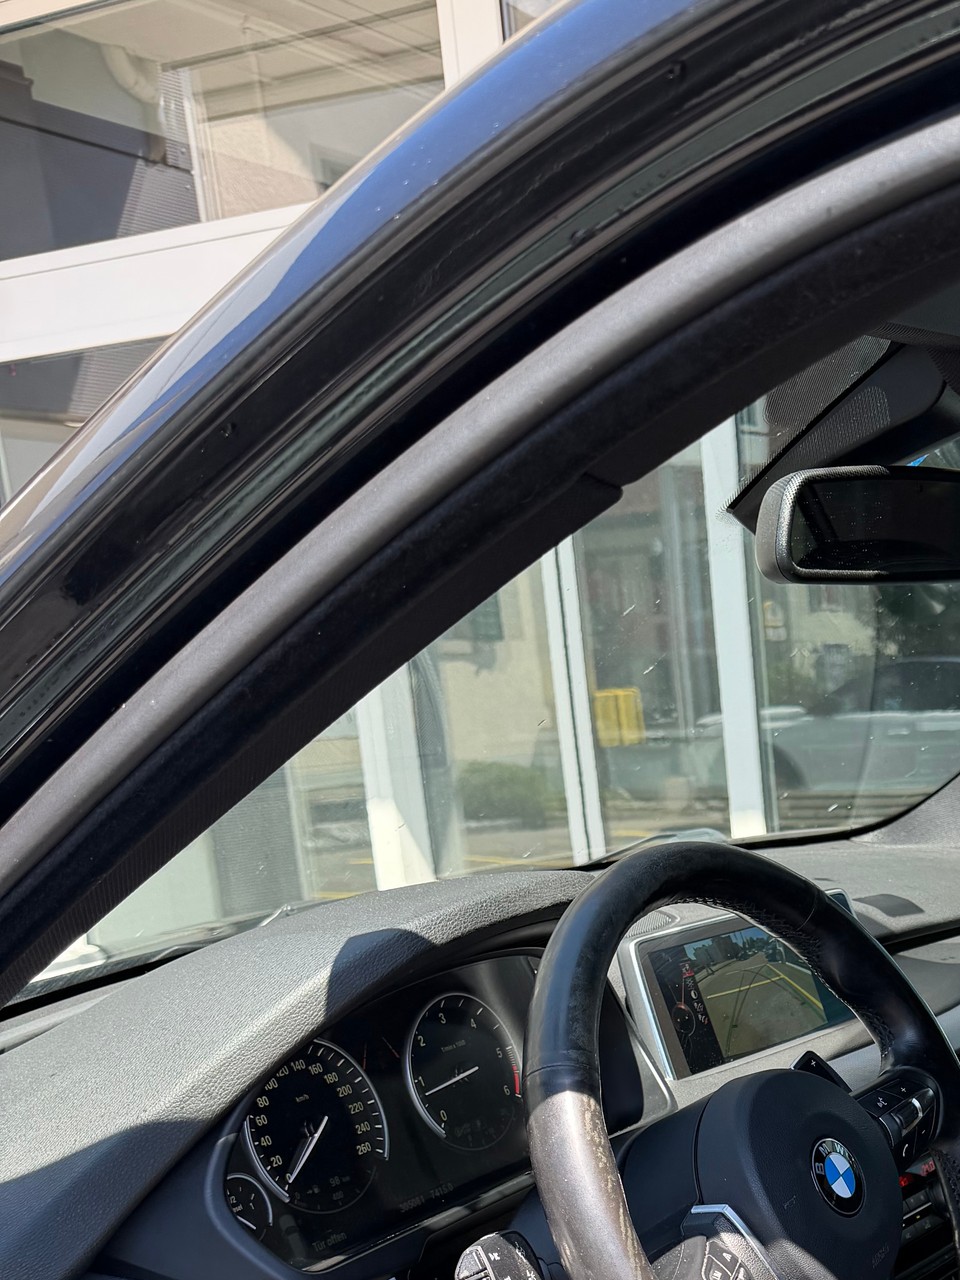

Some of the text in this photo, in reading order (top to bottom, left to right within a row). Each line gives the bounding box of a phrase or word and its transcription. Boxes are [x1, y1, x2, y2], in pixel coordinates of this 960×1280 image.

[438, 1013, 447, 1024] 3
[470, 1018, 478, 1029] 4
[418, 1035, 427, 1047] 2
[496, 1048, 503, 1058] 5
[290, 1059, 306, 1072] 140
[308, 1062, 323, 1076] 160
[323, 1072, 339, 1085] 180
[419, 1076, 425, 1087] 1
[336, 1084, 353, 1098] 200
[503, 1085, 511, 1096] 6
[256, 1095, 269, 1108] 80
[349, 1101, 364, 1115] 220
[255, 1114, 268, 1126] 60
[440, 1109, 447, 1121] 0
[355, 1121, 371, 1134] 240
[261, 1135, 272, 1147] 40
[356, 1141, 371, 1155] 260
[270, 1154, 282, 1167] 20
[286, 1173, 292, 1183] 0
